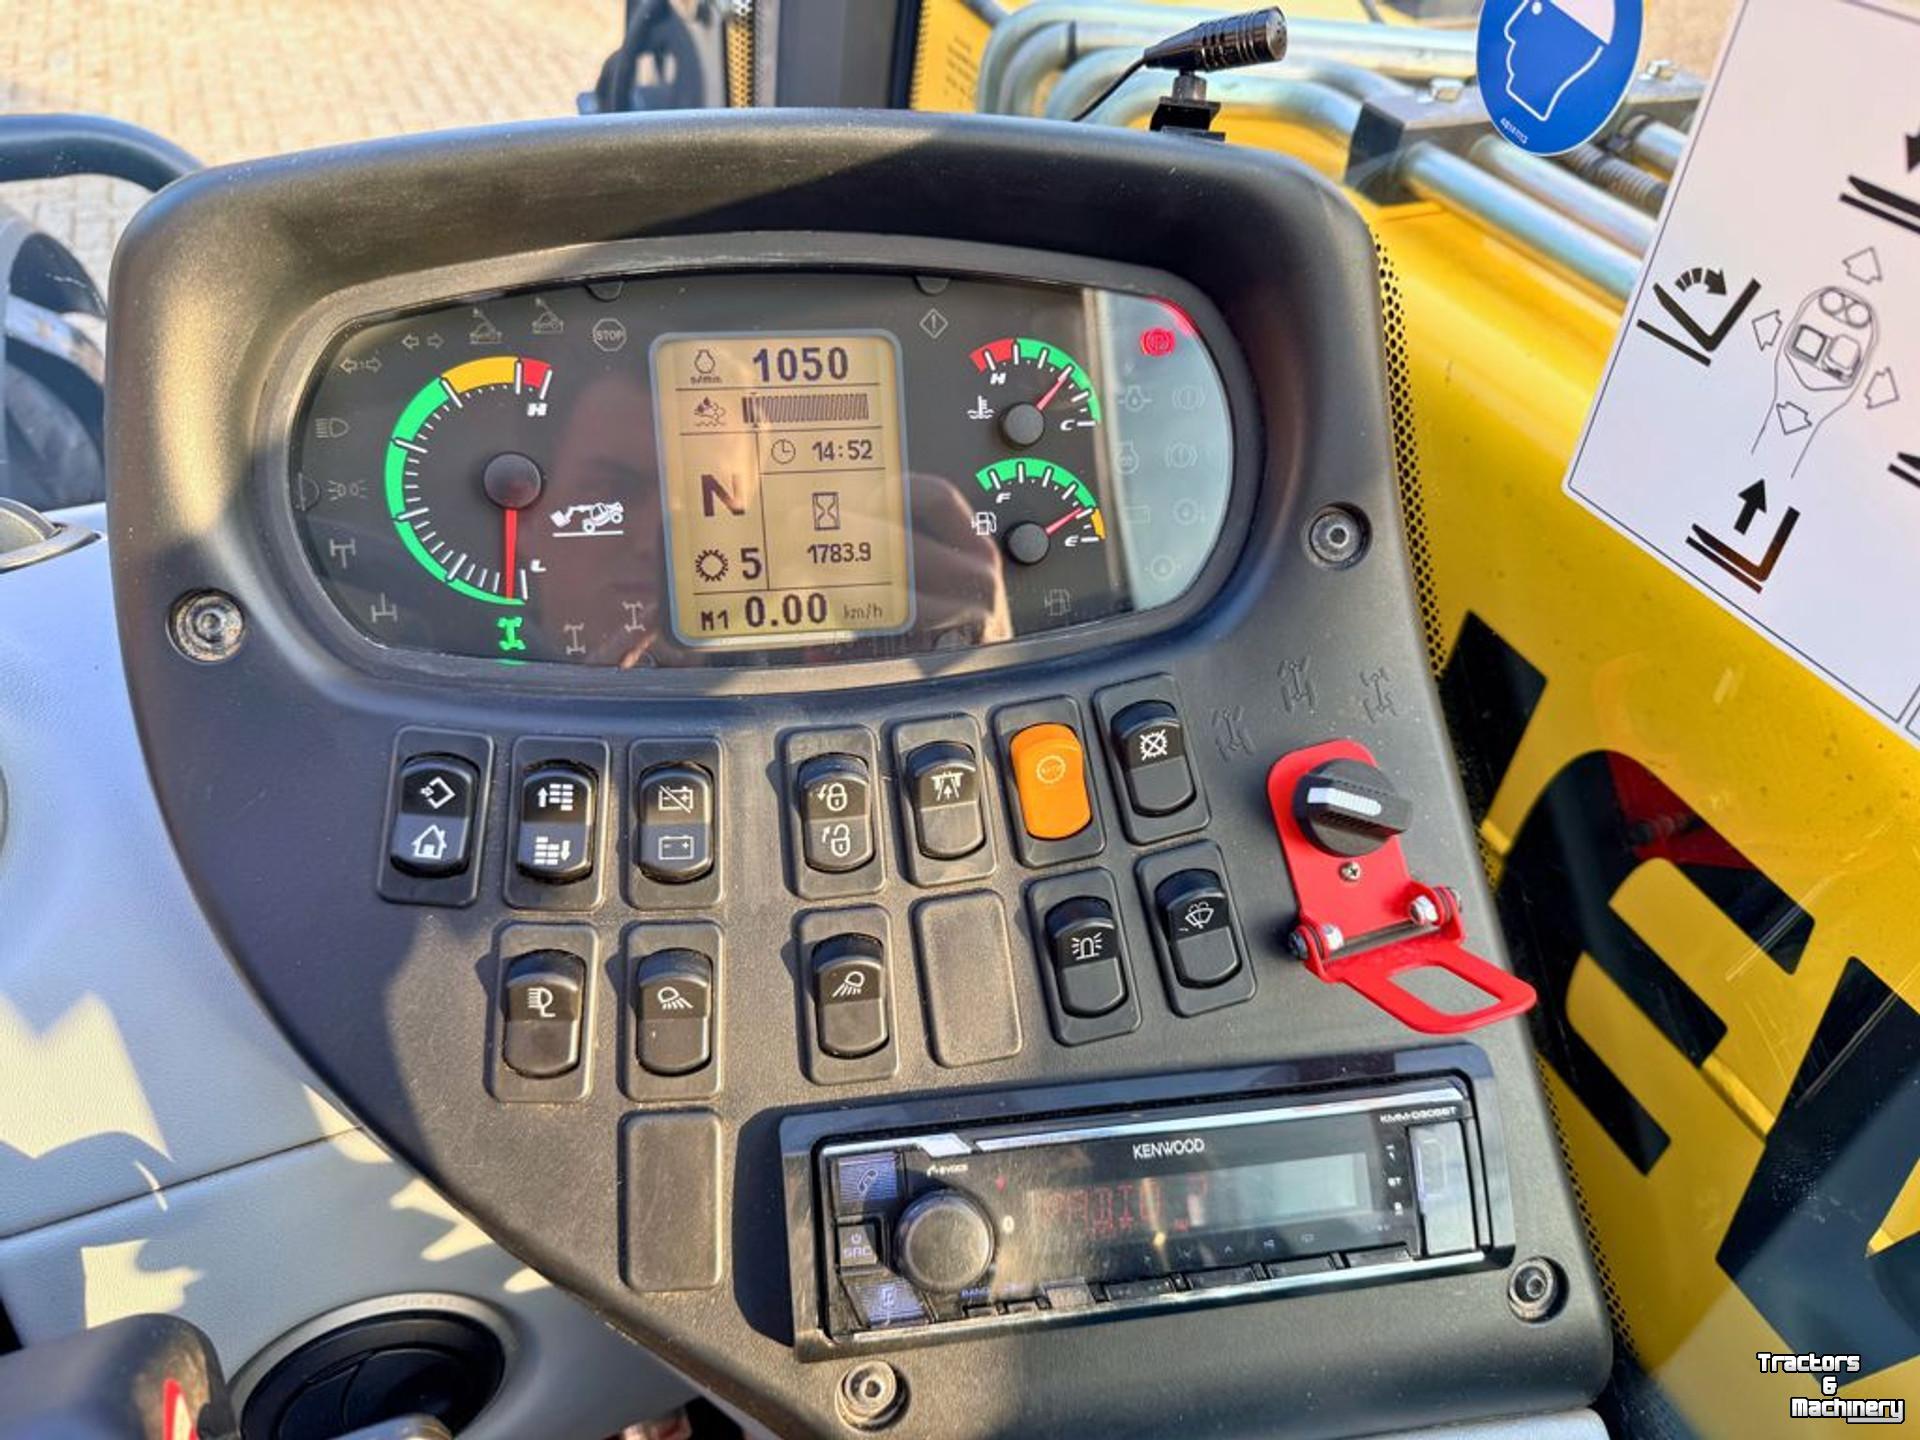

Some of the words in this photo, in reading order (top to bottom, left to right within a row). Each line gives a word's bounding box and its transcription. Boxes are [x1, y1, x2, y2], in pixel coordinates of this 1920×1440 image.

[596, 329, 623, 341] STOP
[752, 347, 848, 382] 1050
[812, 439, 873, 462] 14:52
[701, 474, 745, 517] N
[740, 547, 762, 580] 5
[807, 542, 871, 564] 1783.9
[701, 610, 729, 631] M1
[745, 593, 828, 628] 0.00
[843, 603, 883, 621] km/h
[1132, 1138, 1205, 1160] KENWOOD
